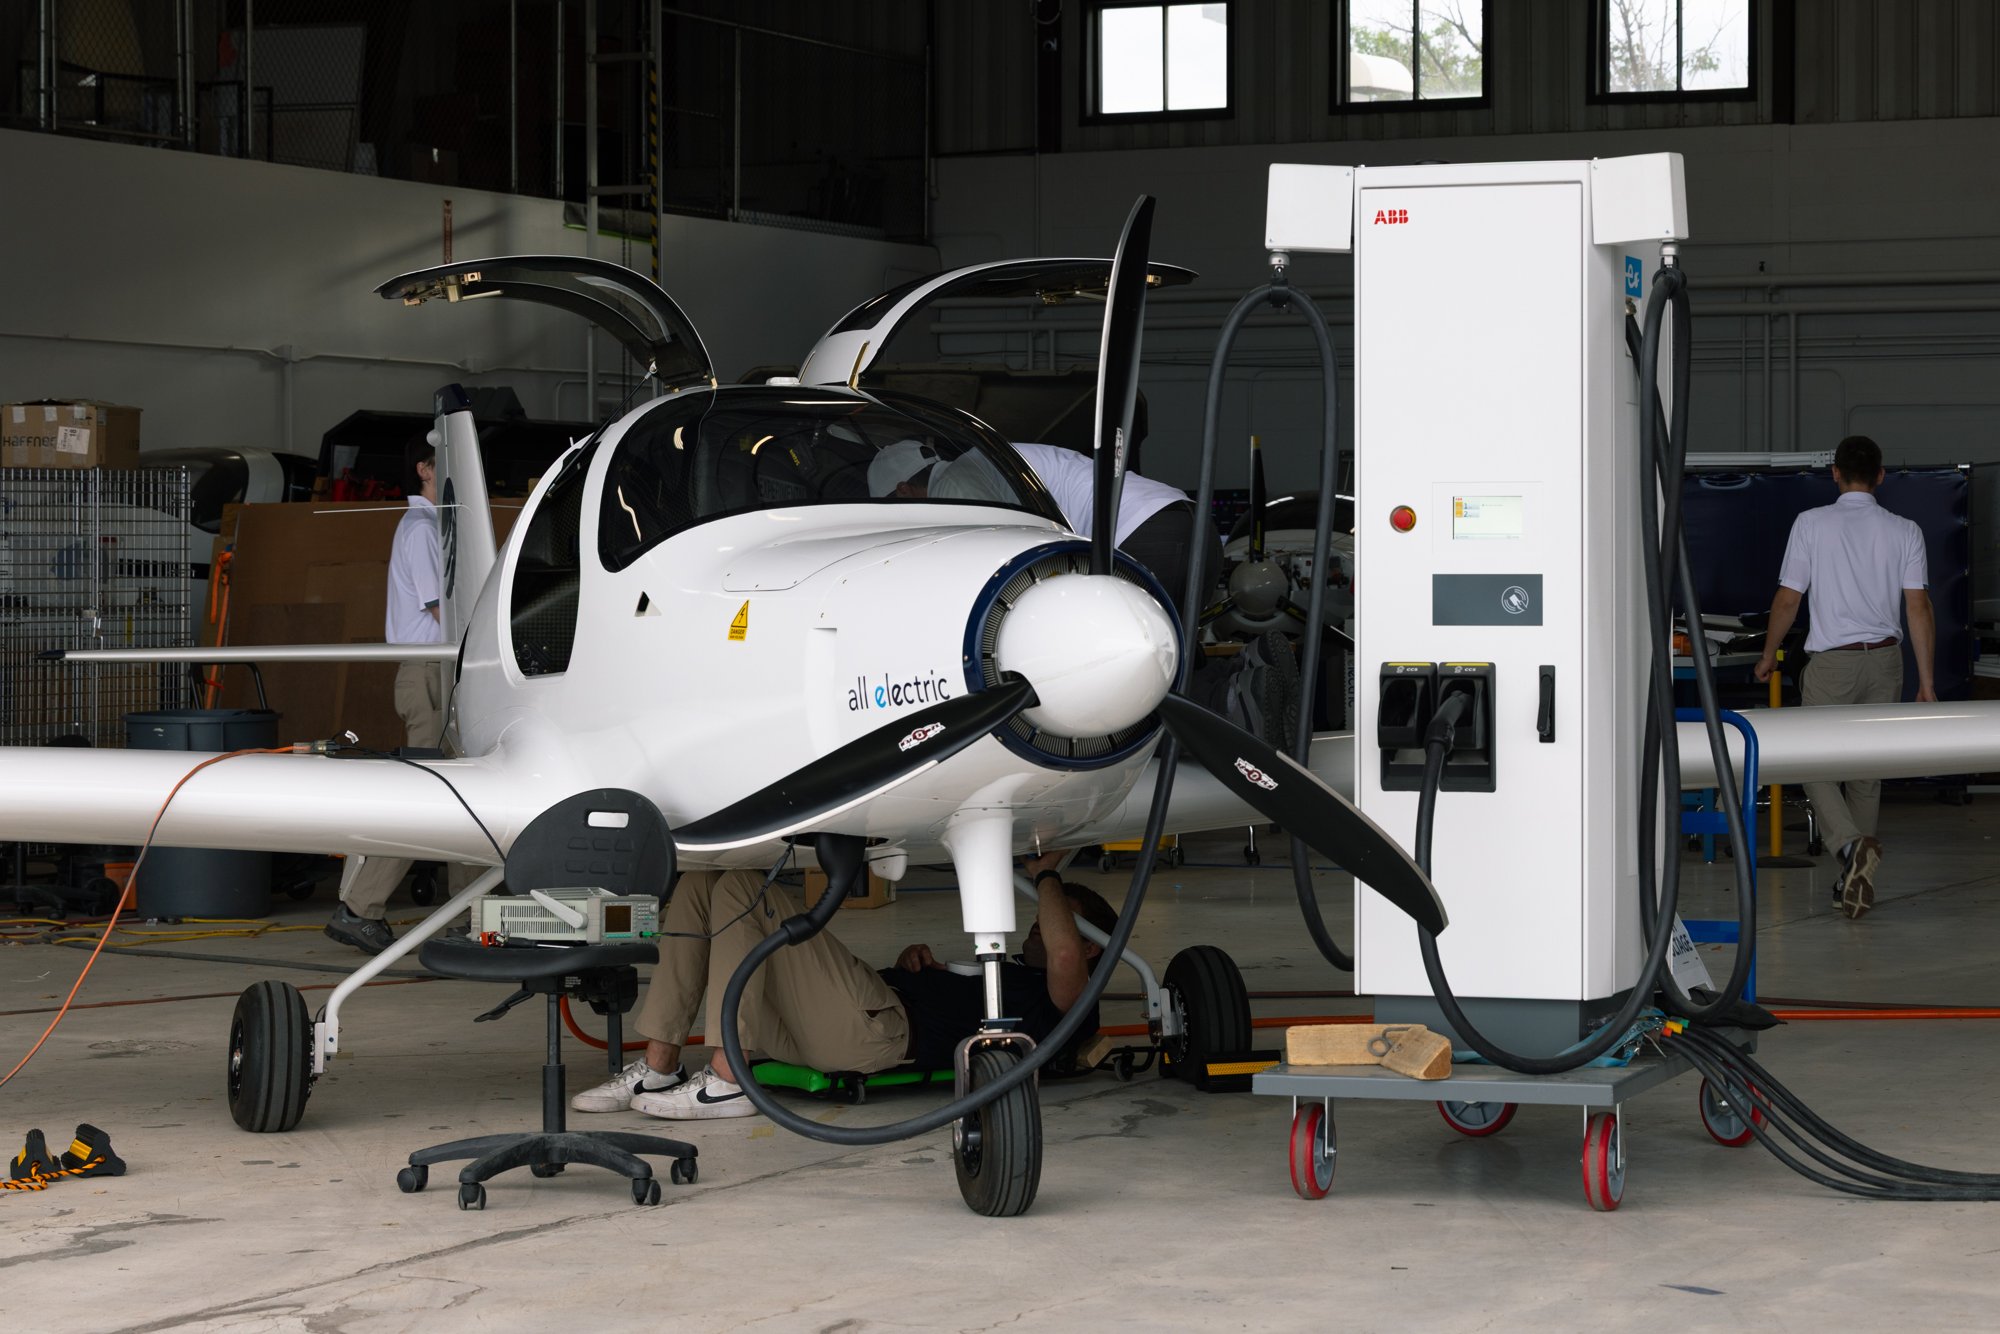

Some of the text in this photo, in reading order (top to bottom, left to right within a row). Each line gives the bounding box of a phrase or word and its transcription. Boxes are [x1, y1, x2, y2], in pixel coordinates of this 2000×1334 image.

[1374, 209, 1409, 225] ABB
[848, 669, 951, 711] all electric
